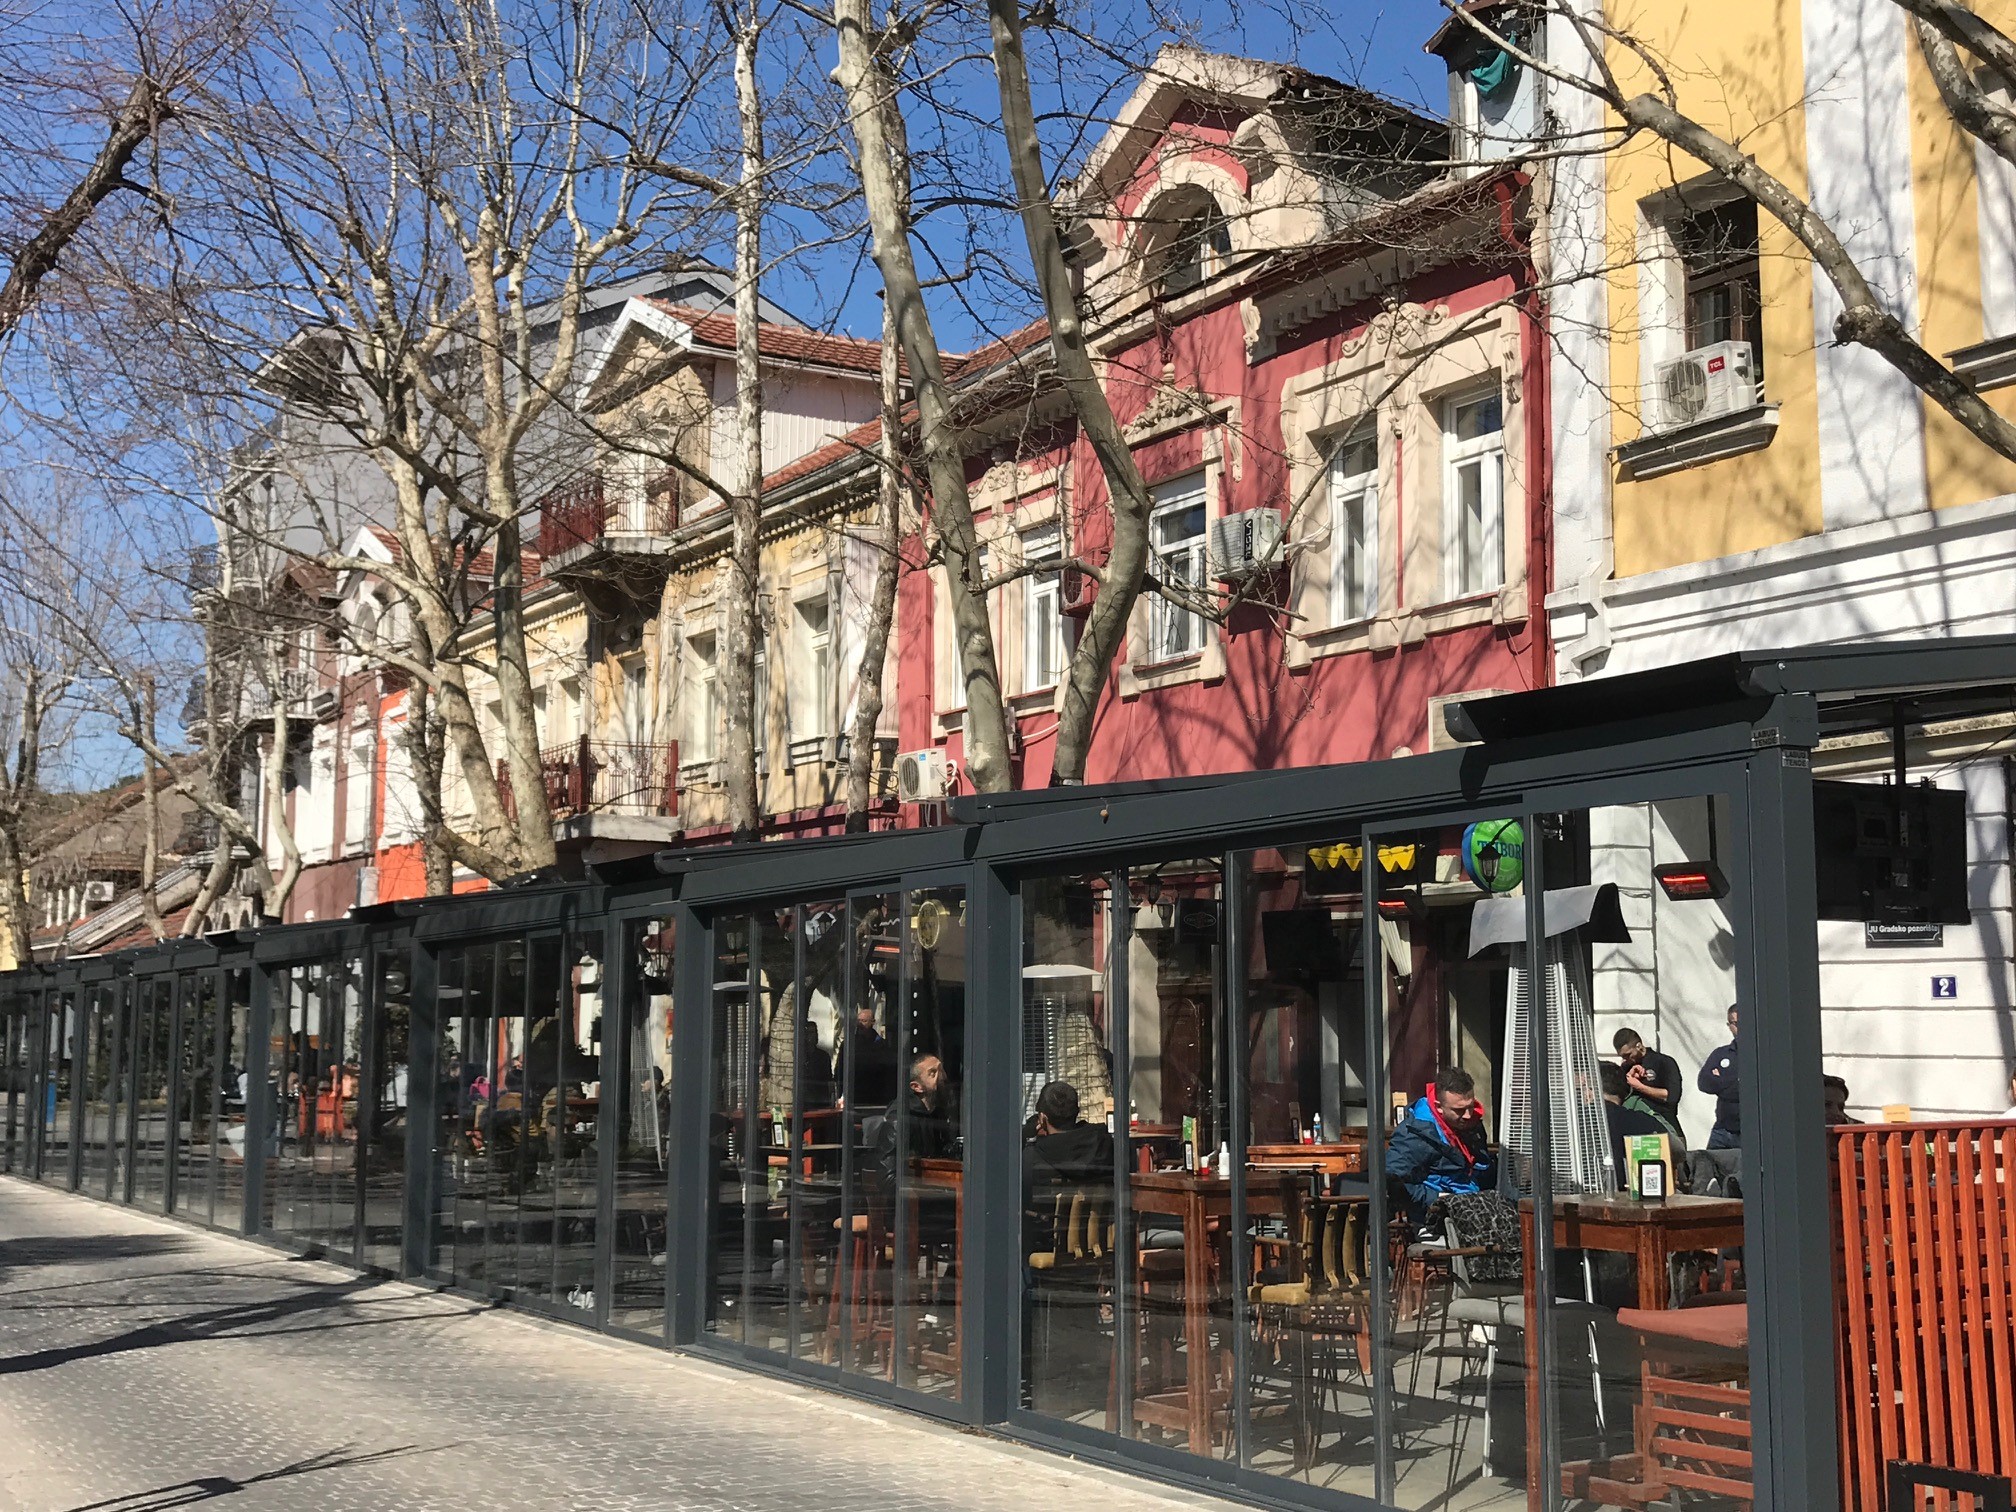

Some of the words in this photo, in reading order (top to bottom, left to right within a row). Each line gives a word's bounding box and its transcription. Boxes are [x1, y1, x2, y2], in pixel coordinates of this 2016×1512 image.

[1709, 361, 1723, 369] TCL
[1477, 841, 1522, 860] TBOR
[1879, 925, 1907, 933] Gradsko
[1939, 978, 1950, 996] 2
